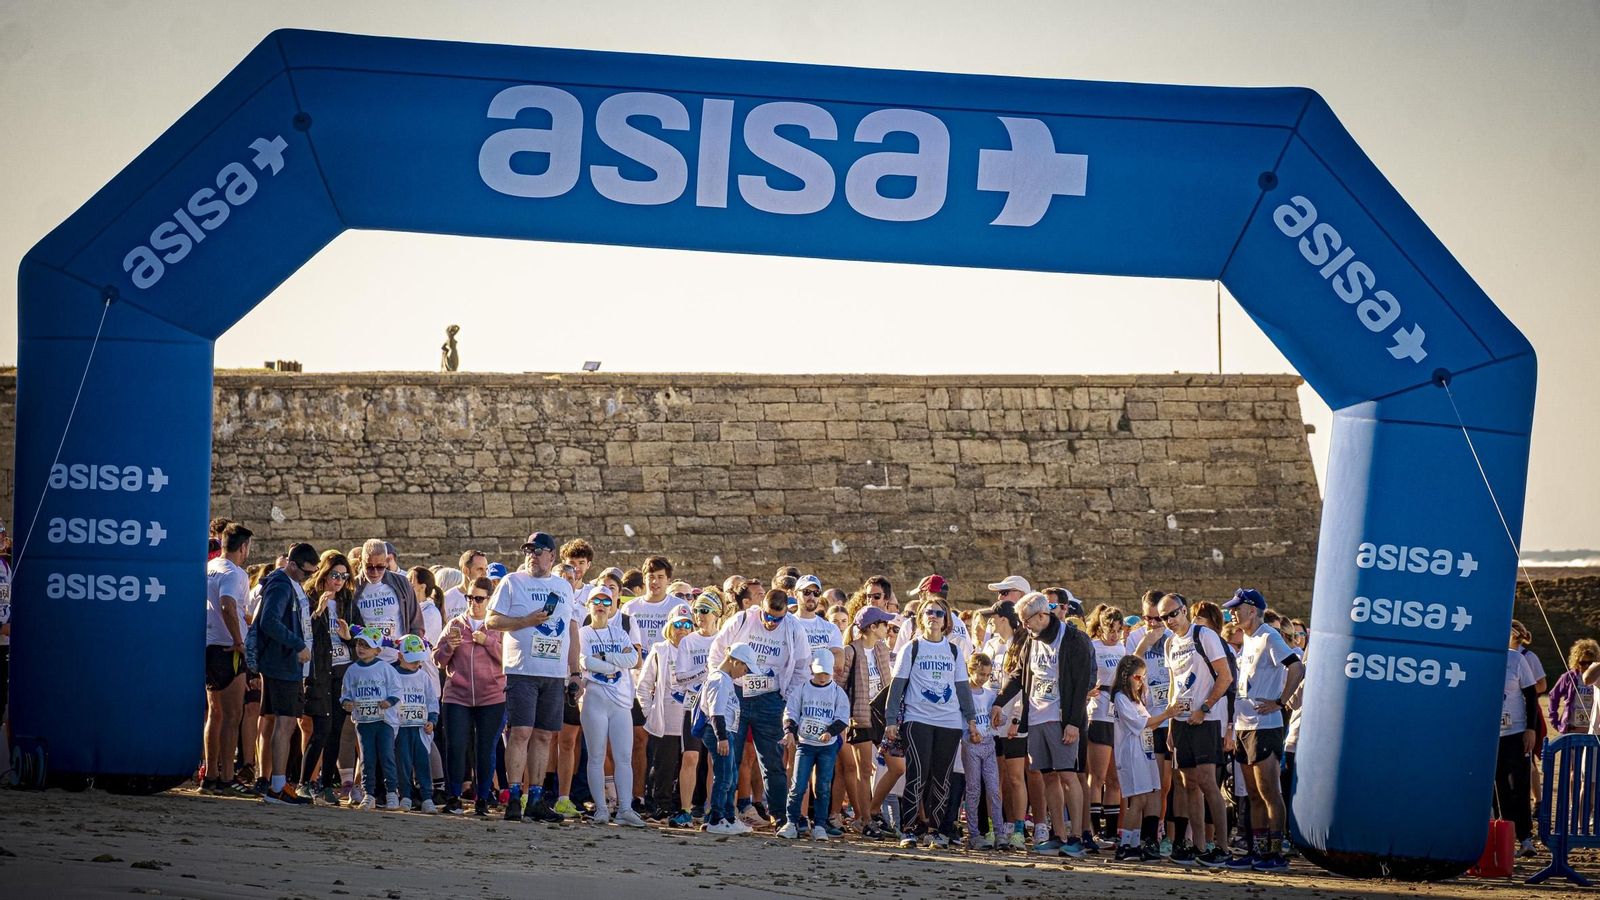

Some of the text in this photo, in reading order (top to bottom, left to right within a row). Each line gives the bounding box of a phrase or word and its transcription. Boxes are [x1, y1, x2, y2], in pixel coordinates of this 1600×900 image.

[478, 85, 950, 222] asisa
[122, 161, 259, 290] asisa
[1273, 195, 1402, 332] asisa
[50, 463, 143, 492] asisa
[47, 517, 142, 546] asisa
[1356, 542, 1453, 576] asisa
[46, 572, 141, 602] asisa
[360, 596, 396, 609] AUTISMO
[1350, 596, 1447, 630] asisa
[537, 642, 558, 654] 372
[591, 644, 622, 654] AUTISMO
[748, 641, 781, 657] AUTISMO
[919, 660, 953, 672] AUTISMO
[1344, 652, 1441, 686] asisa
[355, 686, 382, 697] UTISMO
[748, 680, 767, 690] 391
[403, 693, 425, 704] TISMO
[360, 706, 379, 716] 737
[404, 710, 424, 720] 736
